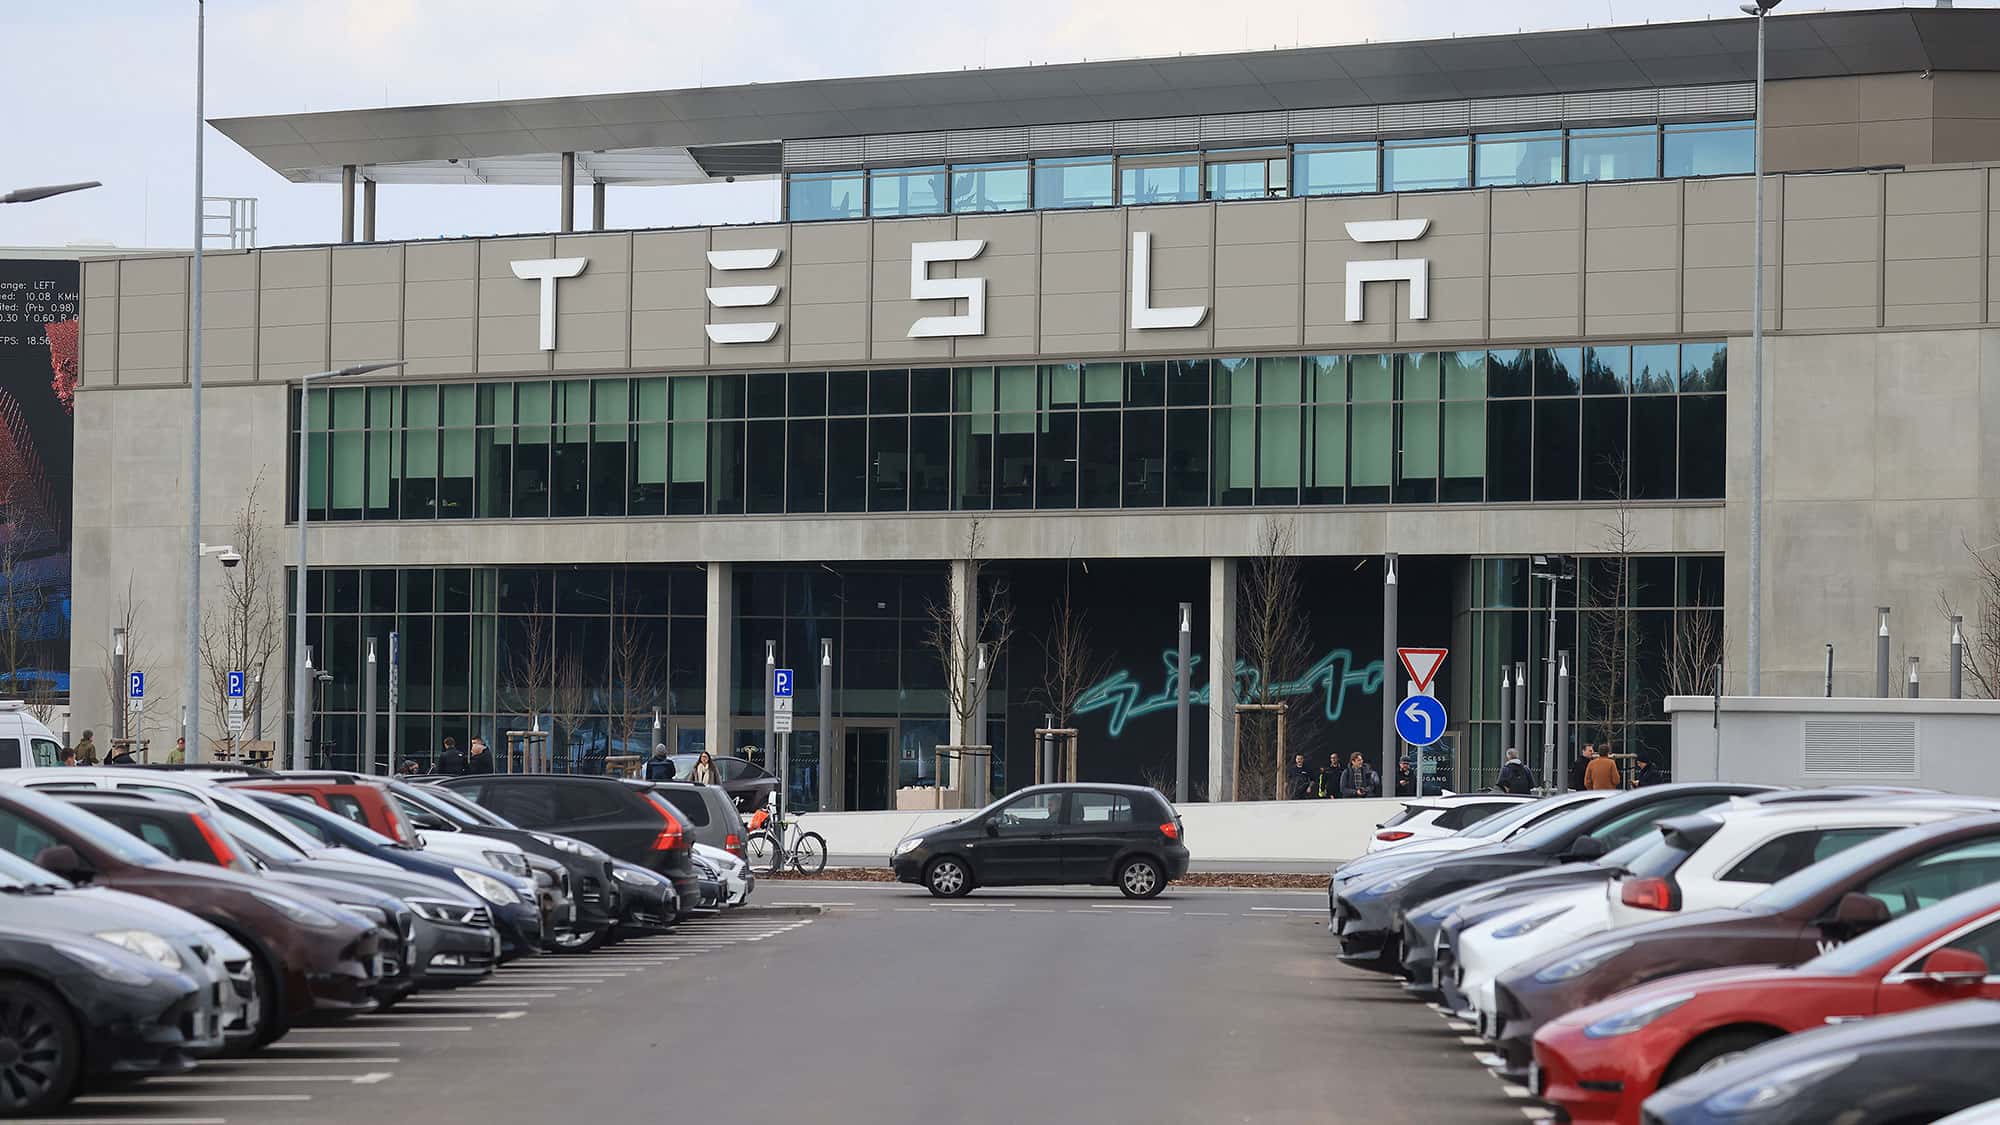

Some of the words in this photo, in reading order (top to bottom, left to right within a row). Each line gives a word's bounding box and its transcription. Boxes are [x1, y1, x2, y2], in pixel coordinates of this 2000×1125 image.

[33, 281, 56, 290] LEFT
[510, 218, 1431, 351] TESLA
[25, 292, 51, 301] 10.08
[57, 292, 79, 301] KMH
[25, 302, 45, 313] (Prb
[50, 302, 75, 313] 0.98)
[24, 313, 30, 322] Y
[33, 313, 55, 322] 0.60
[60, 313, 67, 322] R
[132, 675, 140, 694] P
[230, 675, 240, 694] P
[776, 673, 788, 693] P
